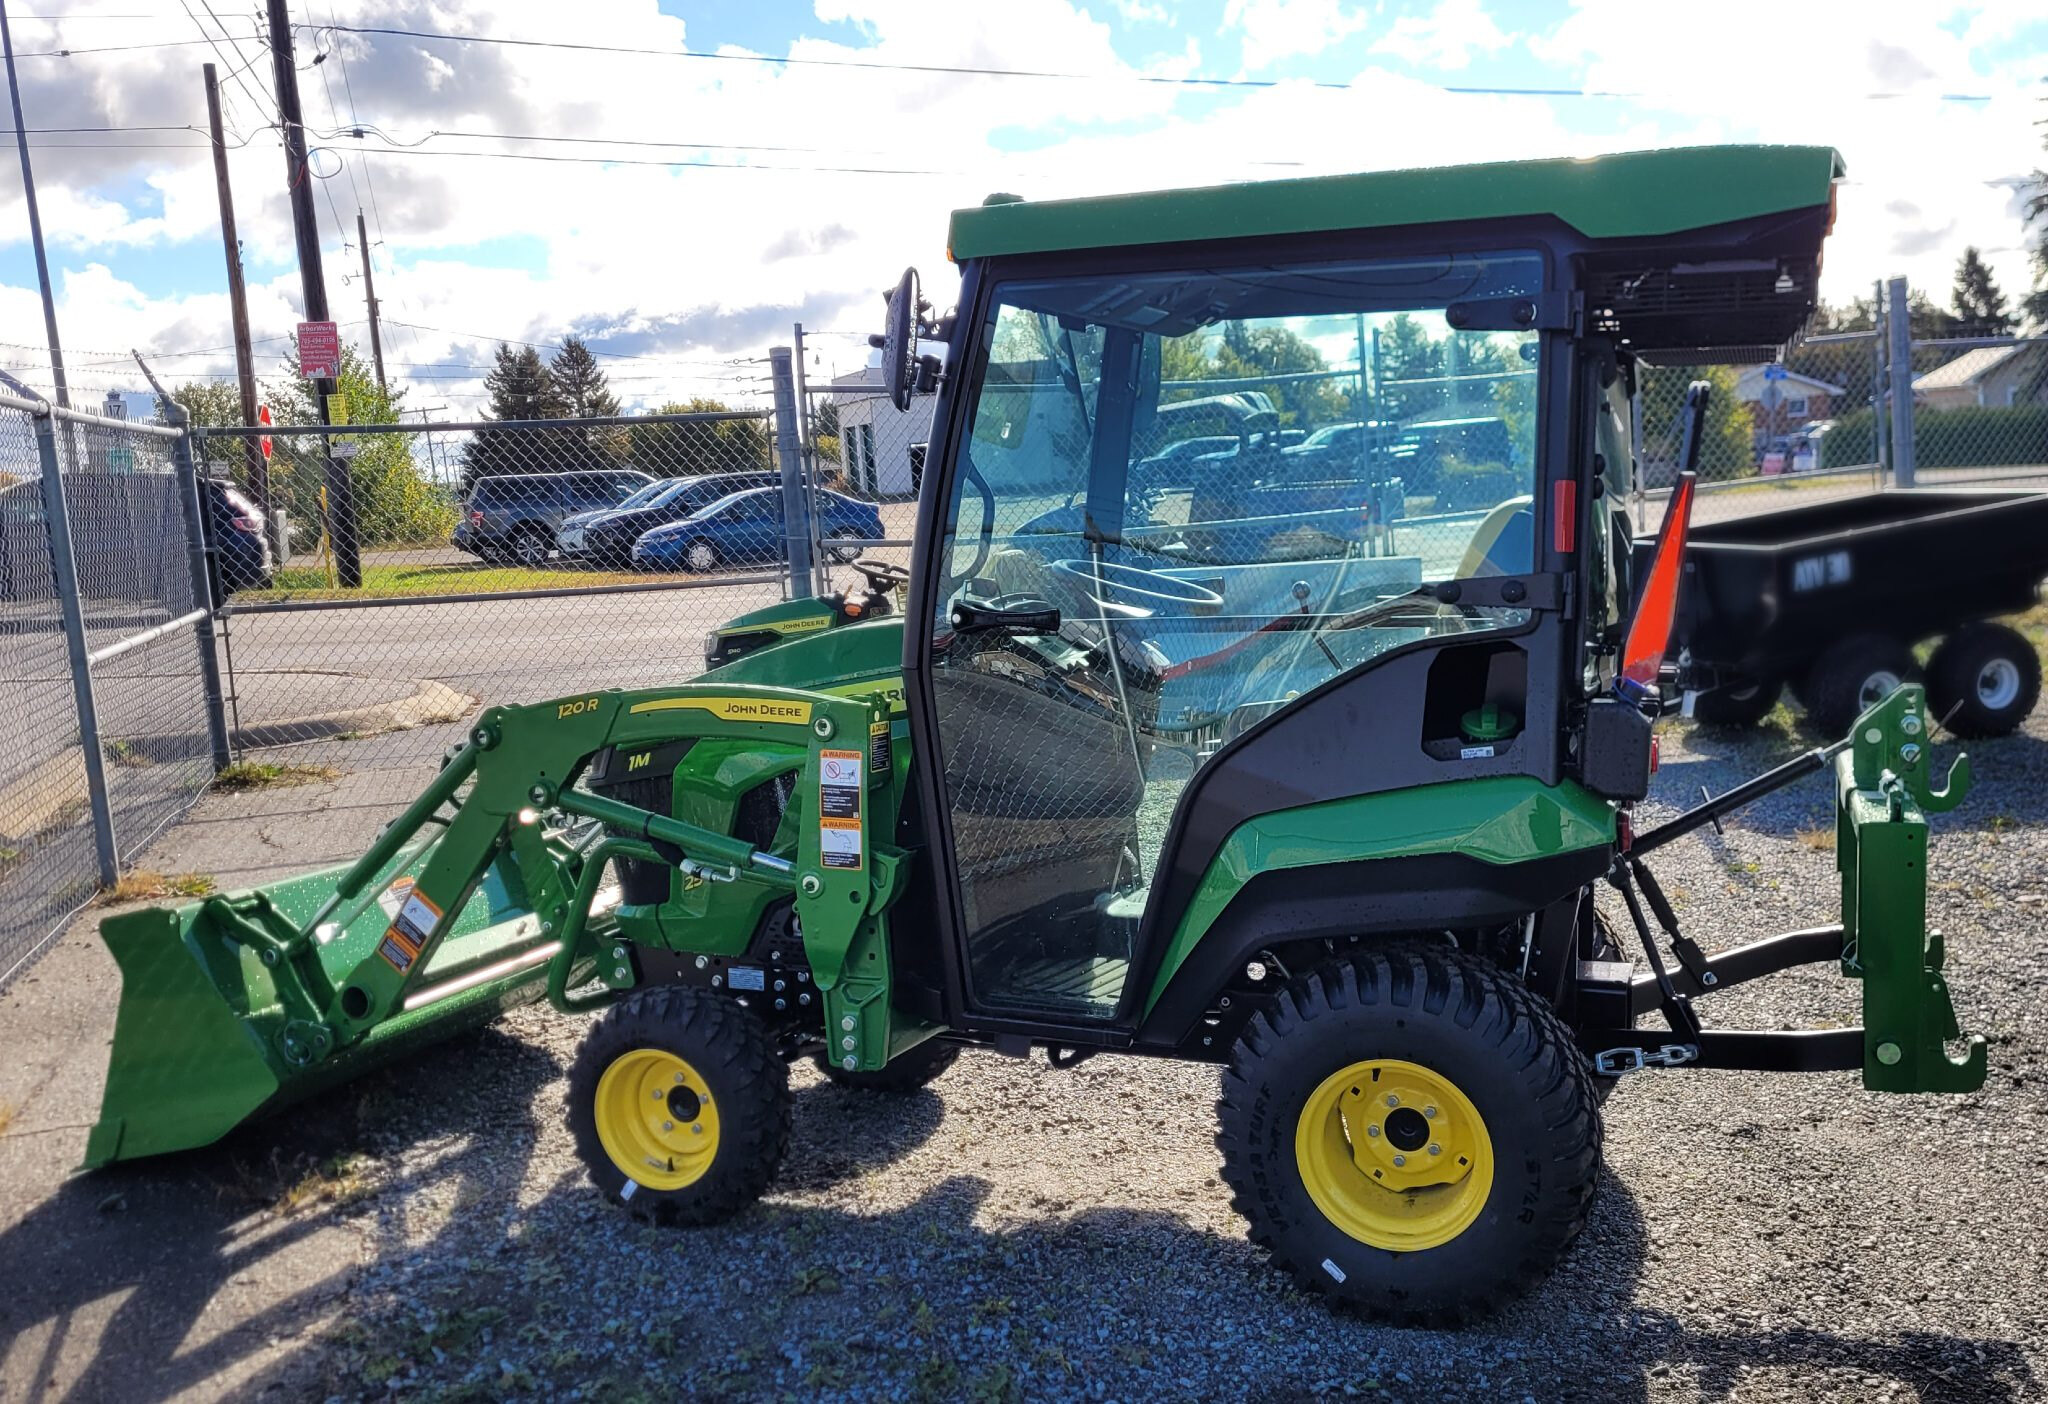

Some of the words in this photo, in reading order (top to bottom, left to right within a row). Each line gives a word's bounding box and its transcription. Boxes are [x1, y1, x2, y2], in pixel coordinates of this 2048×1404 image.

[108, 404, 121, 416] 17
[782, 622, 801, 630] JOHN
[801, 619, 825, 628] DEERE
[558, 701, 585, 720] 120
[587, 698, 599, 712] R
[724, 702, 757, 714] JOHN
[760, 704, 802, 717] DEERE
[829, 751, 860, 759] WARNING
[629, 752, 651, 772] 1M
[828, 821, 860, 829] WARNING
